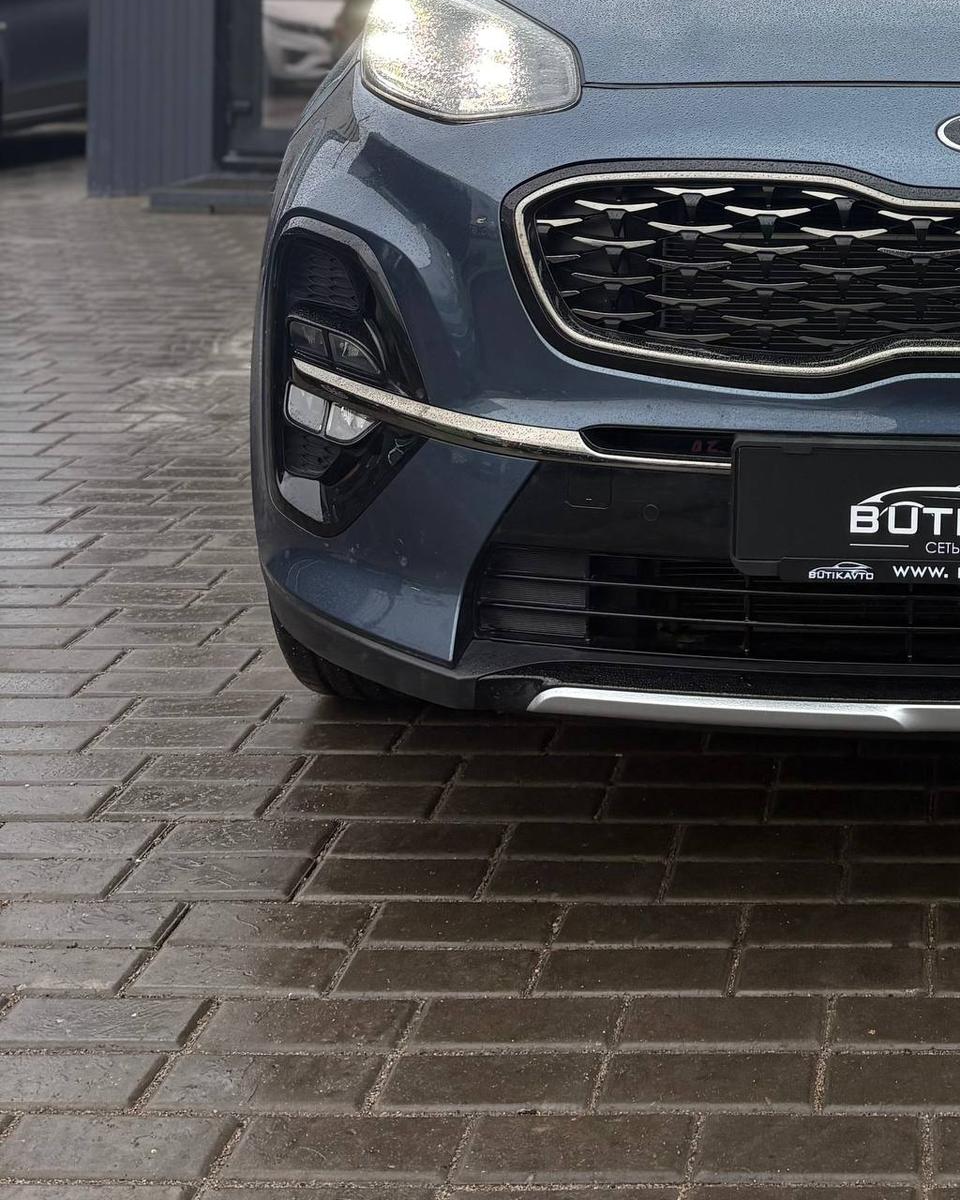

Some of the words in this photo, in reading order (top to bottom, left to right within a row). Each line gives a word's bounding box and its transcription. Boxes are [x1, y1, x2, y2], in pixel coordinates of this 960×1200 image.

[925, 541, 960, 555] СЕТЬ
[808, 570, 874, 581] BUTIKAVTO
[893, 565, 949, 579] WWW.
